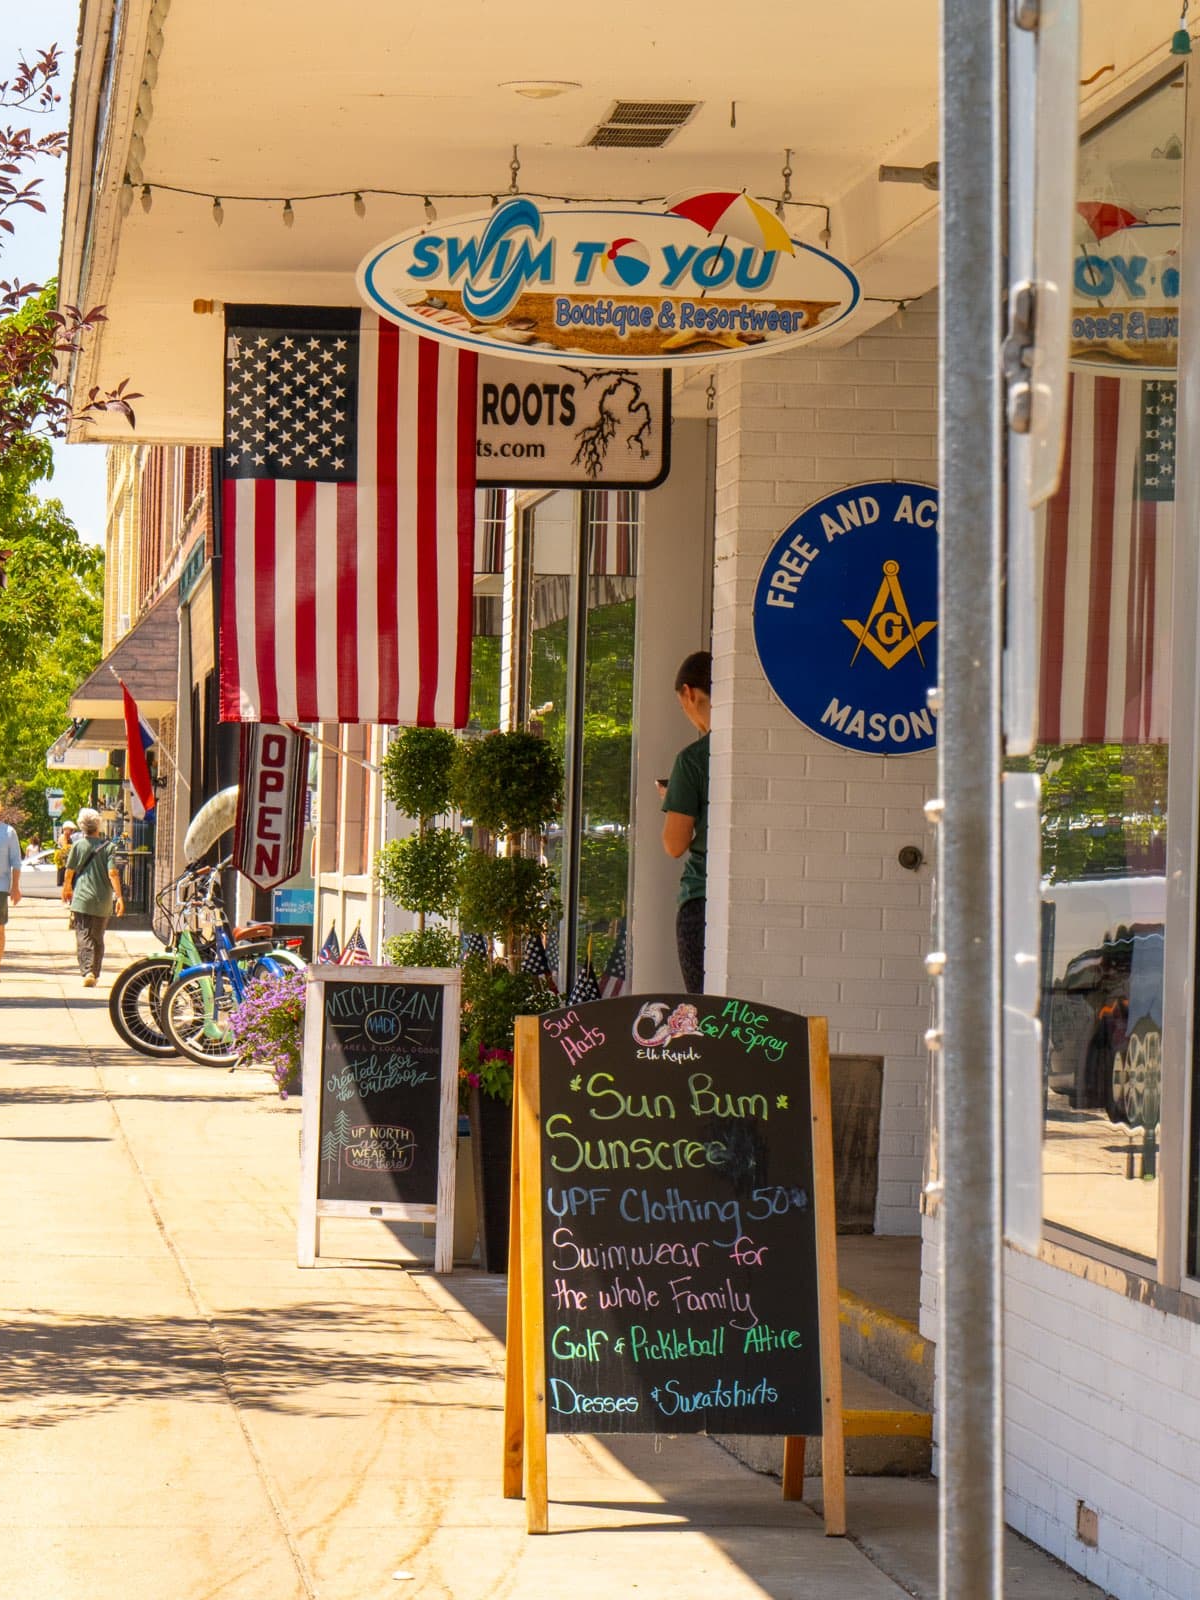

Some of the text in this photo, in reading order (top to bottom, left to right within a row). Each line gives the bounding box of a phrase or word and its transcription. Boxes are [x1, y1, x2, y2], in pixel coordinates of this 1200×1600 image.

[661, 243, 782, 290] YOU
[555, 298, 804, 336] Boutique & Resortwear
[481, 382, 576, 427] ROOTS
[476, 438, 546, 458] ts.com
[766, 534, 820, 608] FREE
[819, 496, 880, 542] AND
[254, 733, 287, 878] OPEN
[325, 984, 441, 1022] MICHIGAN
[721, 1000, 769, 1029] Aloe
[367, 1015, 397, 1036] MADE
[543, 1010, 579, 1038] Sun
[700, 1015, 728, 1039] Gel
[737, 1027, 788, 1062] Spray
[561, 1026, 606, 1066] Hats
[327, 1054, 382, 1092] created
[359, 1069, 437, 1098] outdoors
[586, 1073, 676, 1120] Sun
[351, 1127, 409, 1140] UP NORTH
[545, 1113, 728, 1173] Sunscree
[351, 1149, 404, 1158] WEAR IT
[547, 1187, 611, 1217] UPF
[619, 1188, 745, 1247] Clothing
[552, 1227, 770, 1272] Swimwear for
[551, 1276, 759, 1330] the whole Family
[551, 1326, 609, 1363] Golf
[630, 1325, 725, 1363] Pickleball
[744, 1325, 803, 1354] Attire
[550, 1378, 639, 1415] Dresses
[658, 1377, 778, 1415] Sweatshirts
